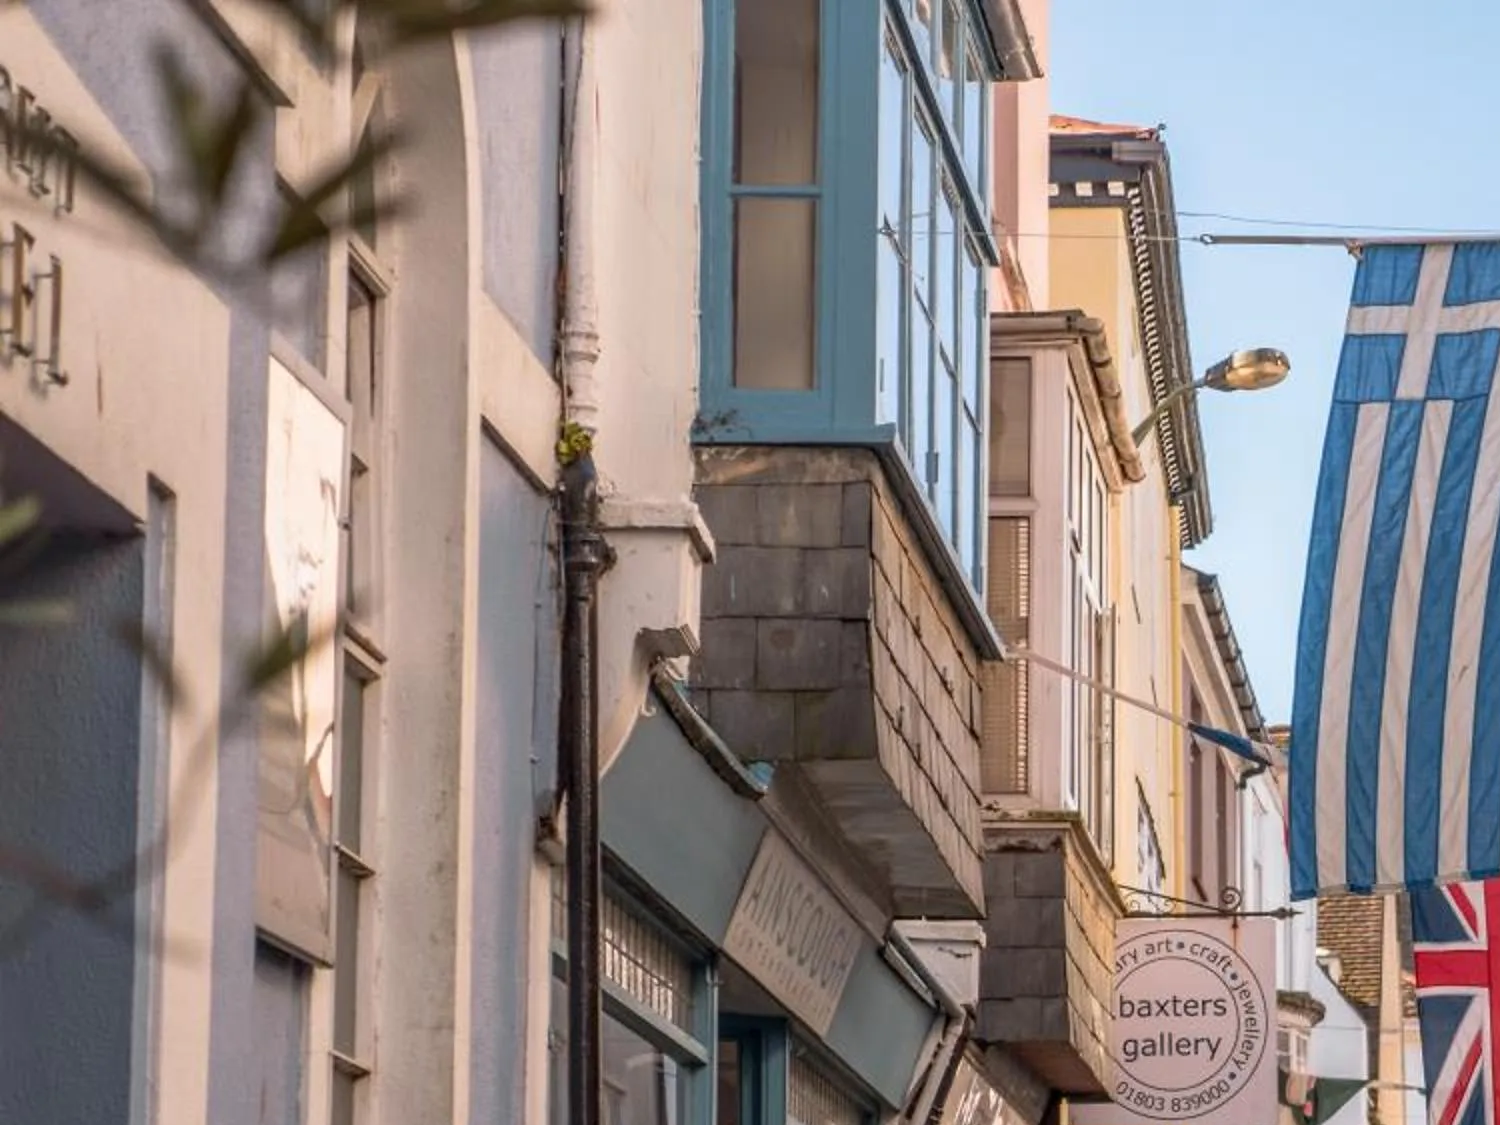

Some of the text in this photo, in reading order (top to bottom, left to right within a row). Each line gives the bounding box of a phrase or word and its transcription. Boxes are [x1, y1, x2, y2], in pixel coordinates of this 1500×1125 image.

[1119, 994, 1227, 1018] baxters
[1144, 936, 1173, 955] art
[1189, 942, 1232, 973] craft
[1231, 978, 1260, 1072] jewellery
[1122, 1031, 1222, 1062] gallery
[1115, 1079, 1231, 1113] 01803 839000
